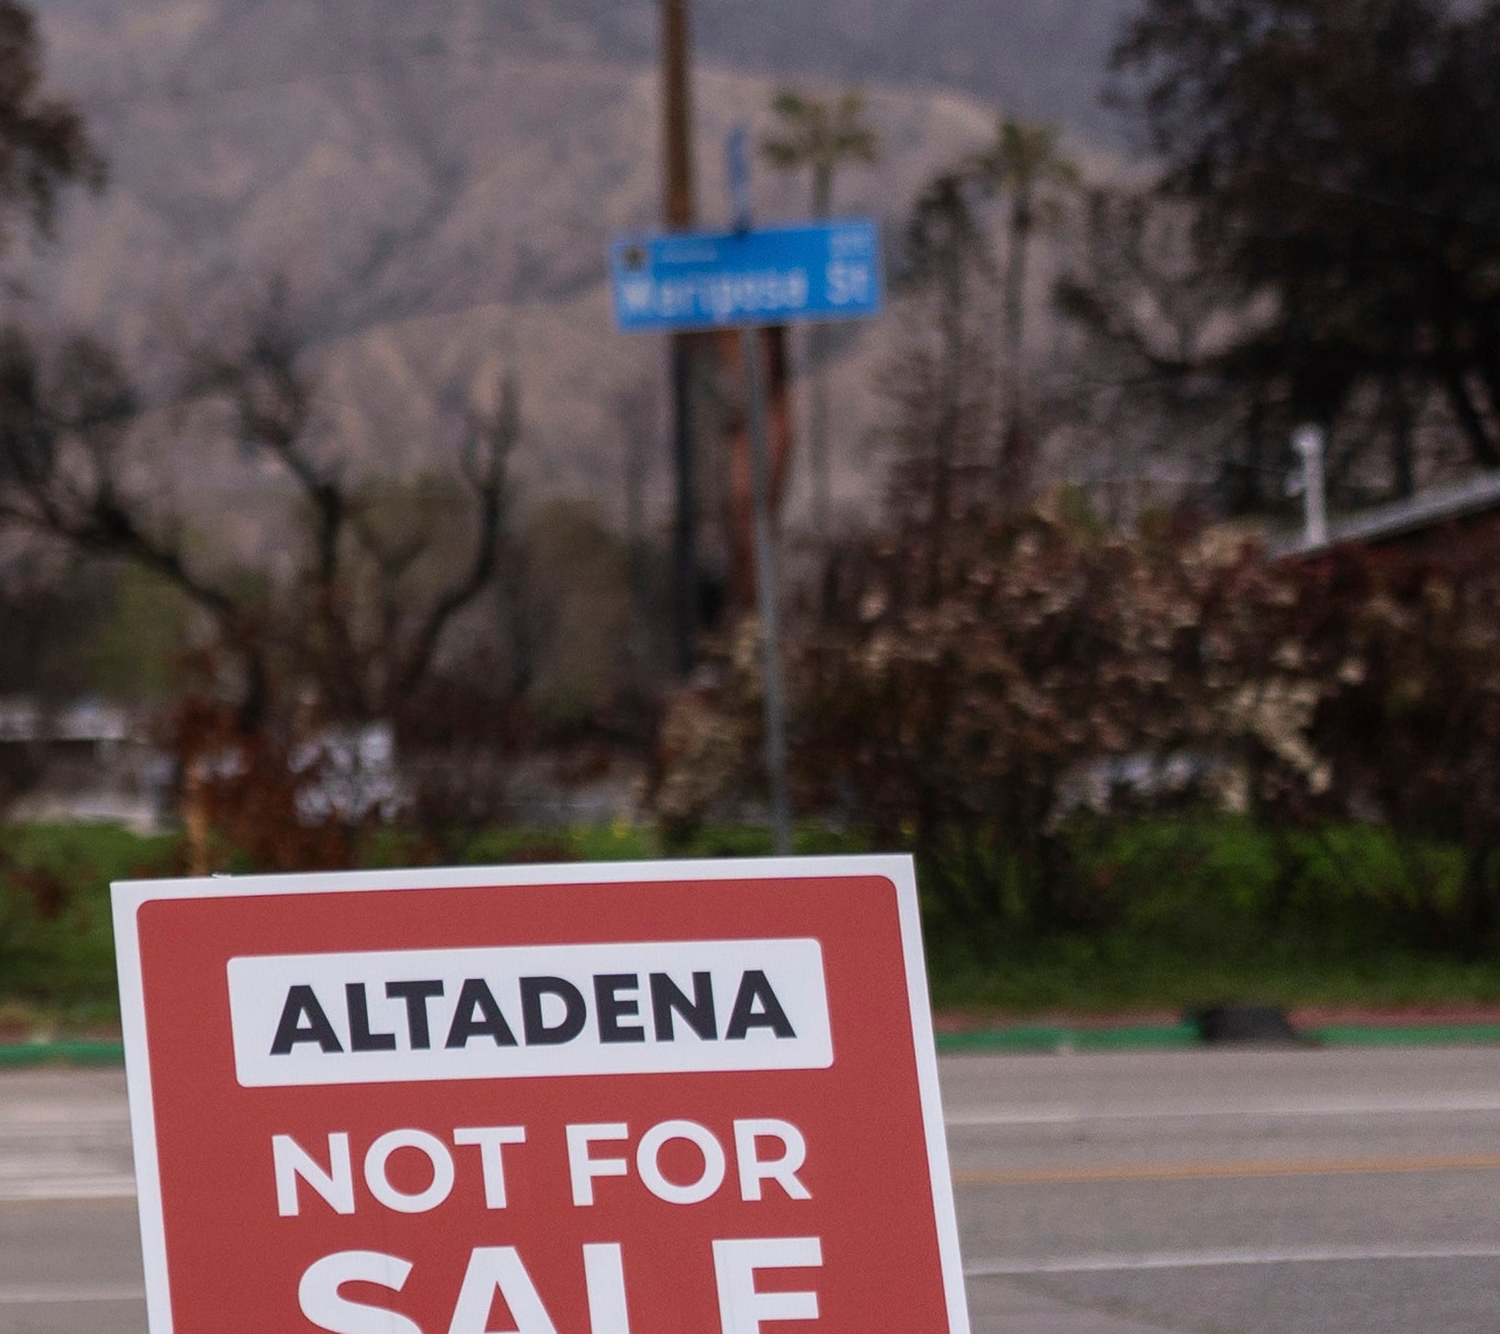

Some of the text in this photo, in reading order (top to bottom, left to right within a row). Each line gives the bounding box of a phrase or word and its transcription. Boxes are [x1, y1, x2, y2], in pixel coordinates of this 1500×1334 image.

[271, 971, 795, 1054] ALTADENA
[272, 1118, 812, 1216] NOT FOR
